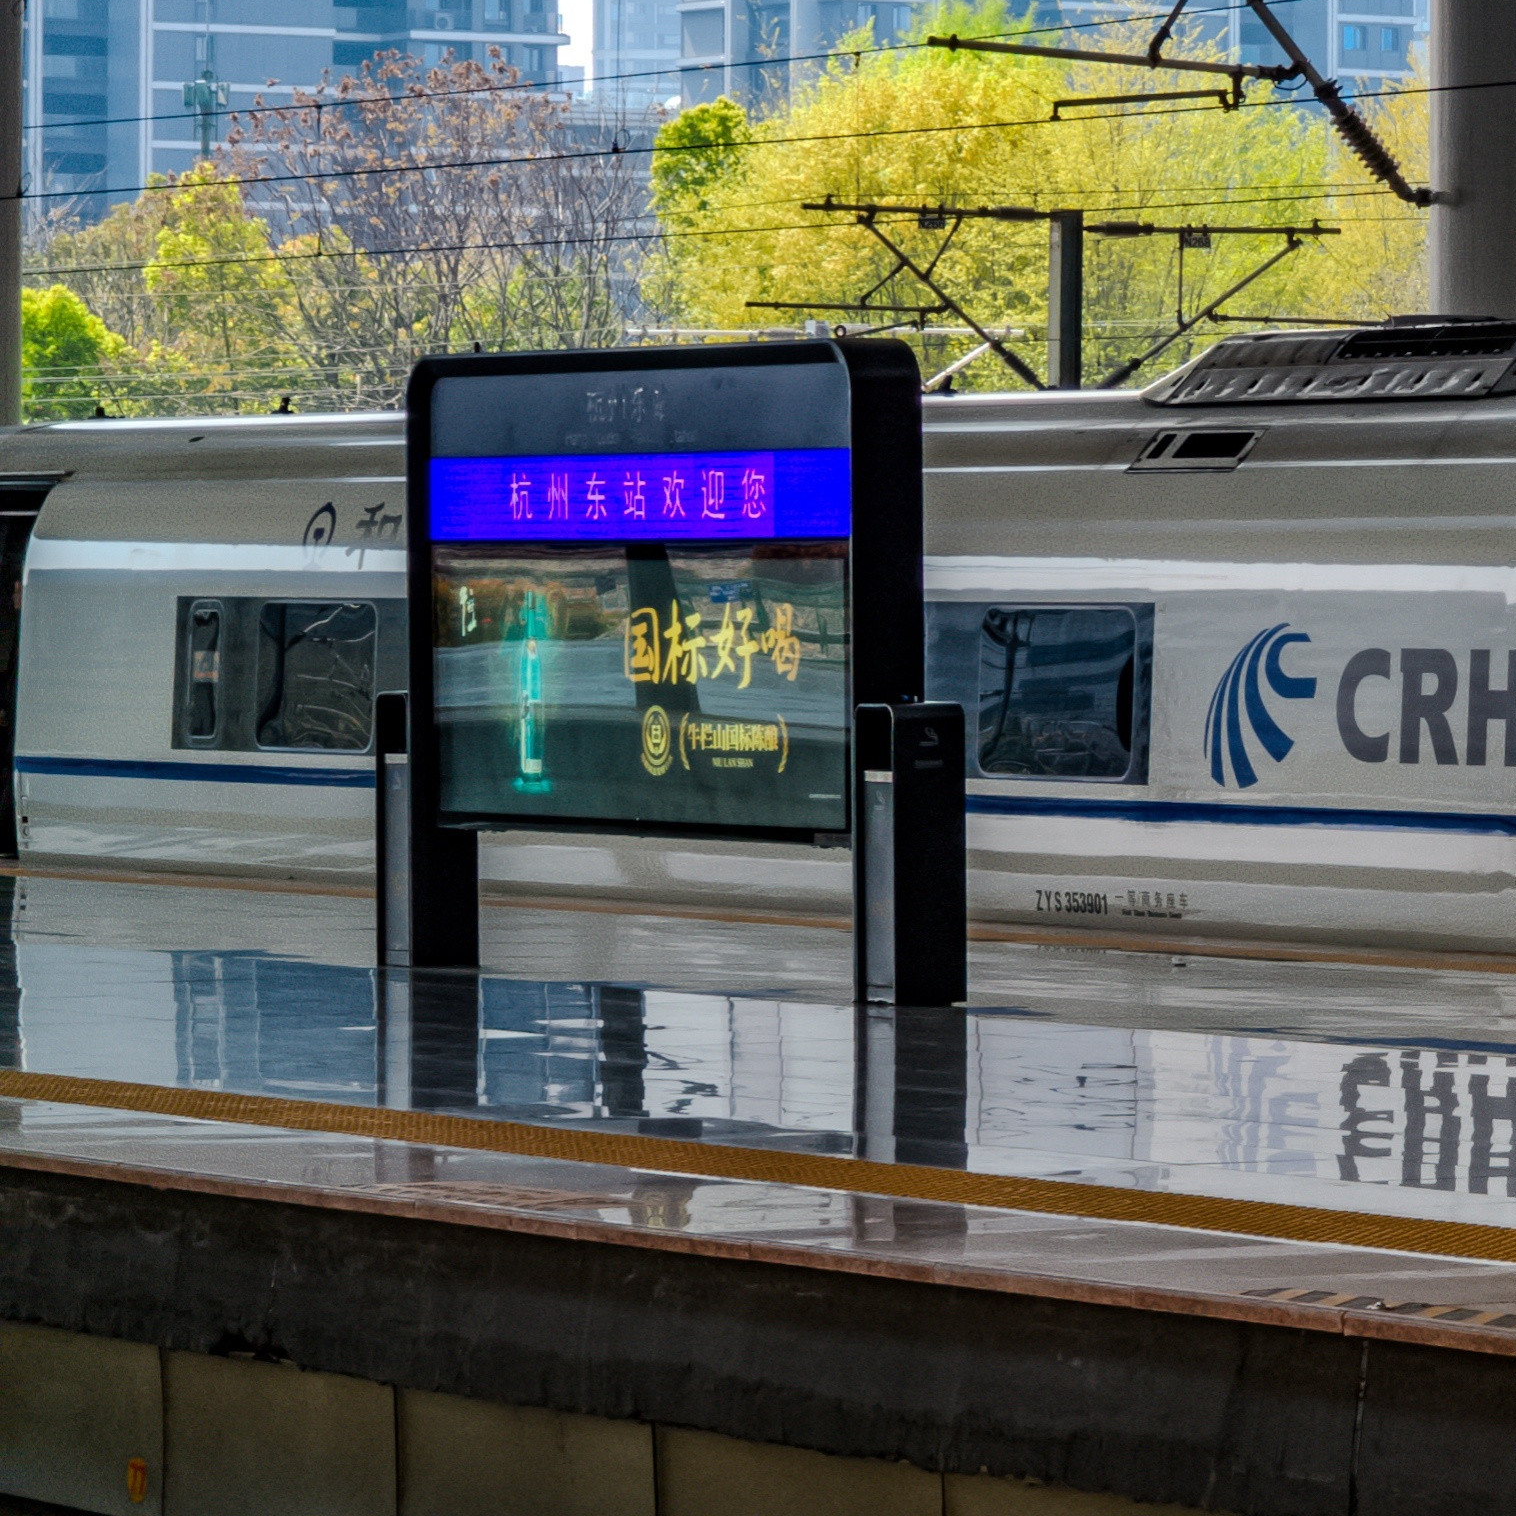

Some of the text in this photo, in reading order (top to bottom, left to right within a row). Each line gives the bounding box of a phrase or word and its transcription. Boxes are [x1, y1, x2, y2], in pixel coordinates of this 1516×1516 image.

[509, 468, 768, 521] 杭州东站欢迎您
[624, 598, 801, 690] 国标好喝
[1035, 889, 1062, 913] ZYS
[1064, 891, 1108, 916] 353901
